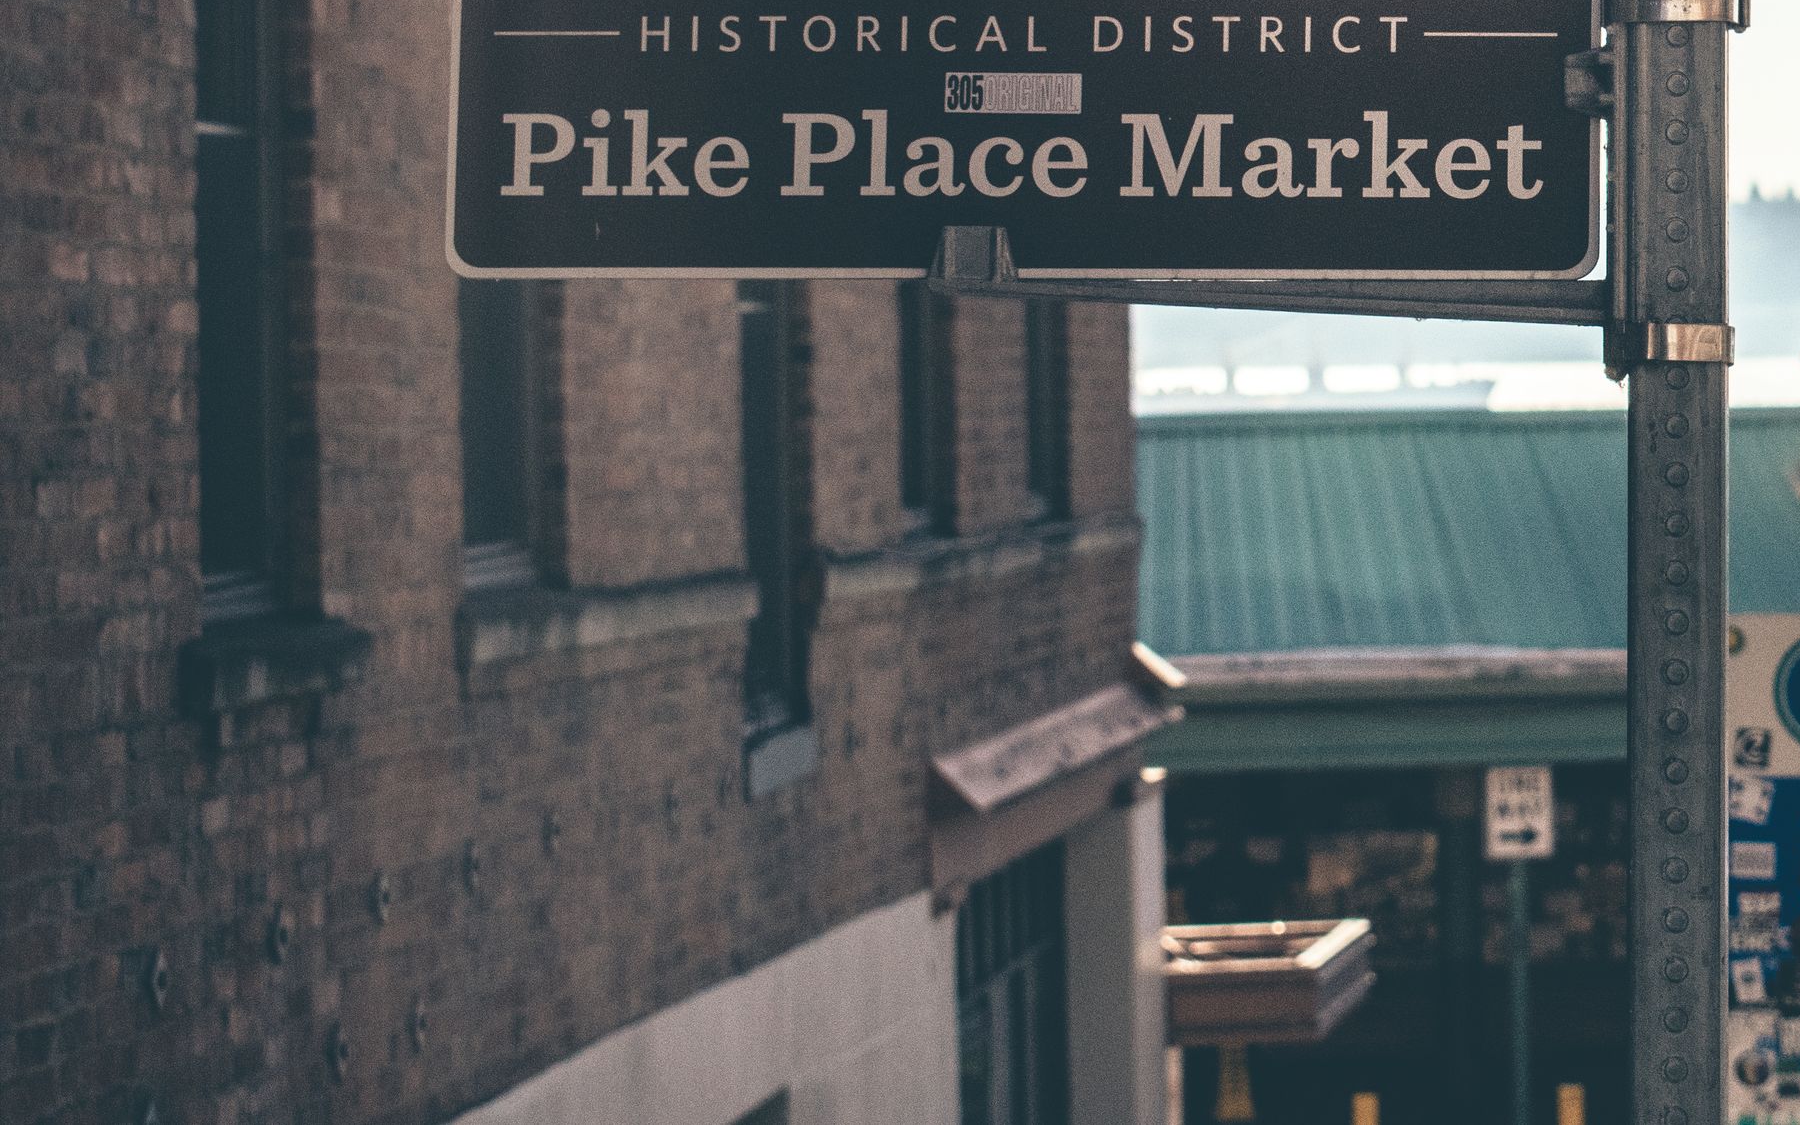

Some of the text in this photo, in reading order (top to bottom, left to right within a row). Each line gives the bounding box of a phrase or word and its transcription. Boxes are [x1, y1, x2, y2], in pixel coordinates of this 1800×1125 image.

[640, 15, 1410, 55] HISTORICAL DISTRICT
[500, 109, 1544, 201] Pike Place Market
